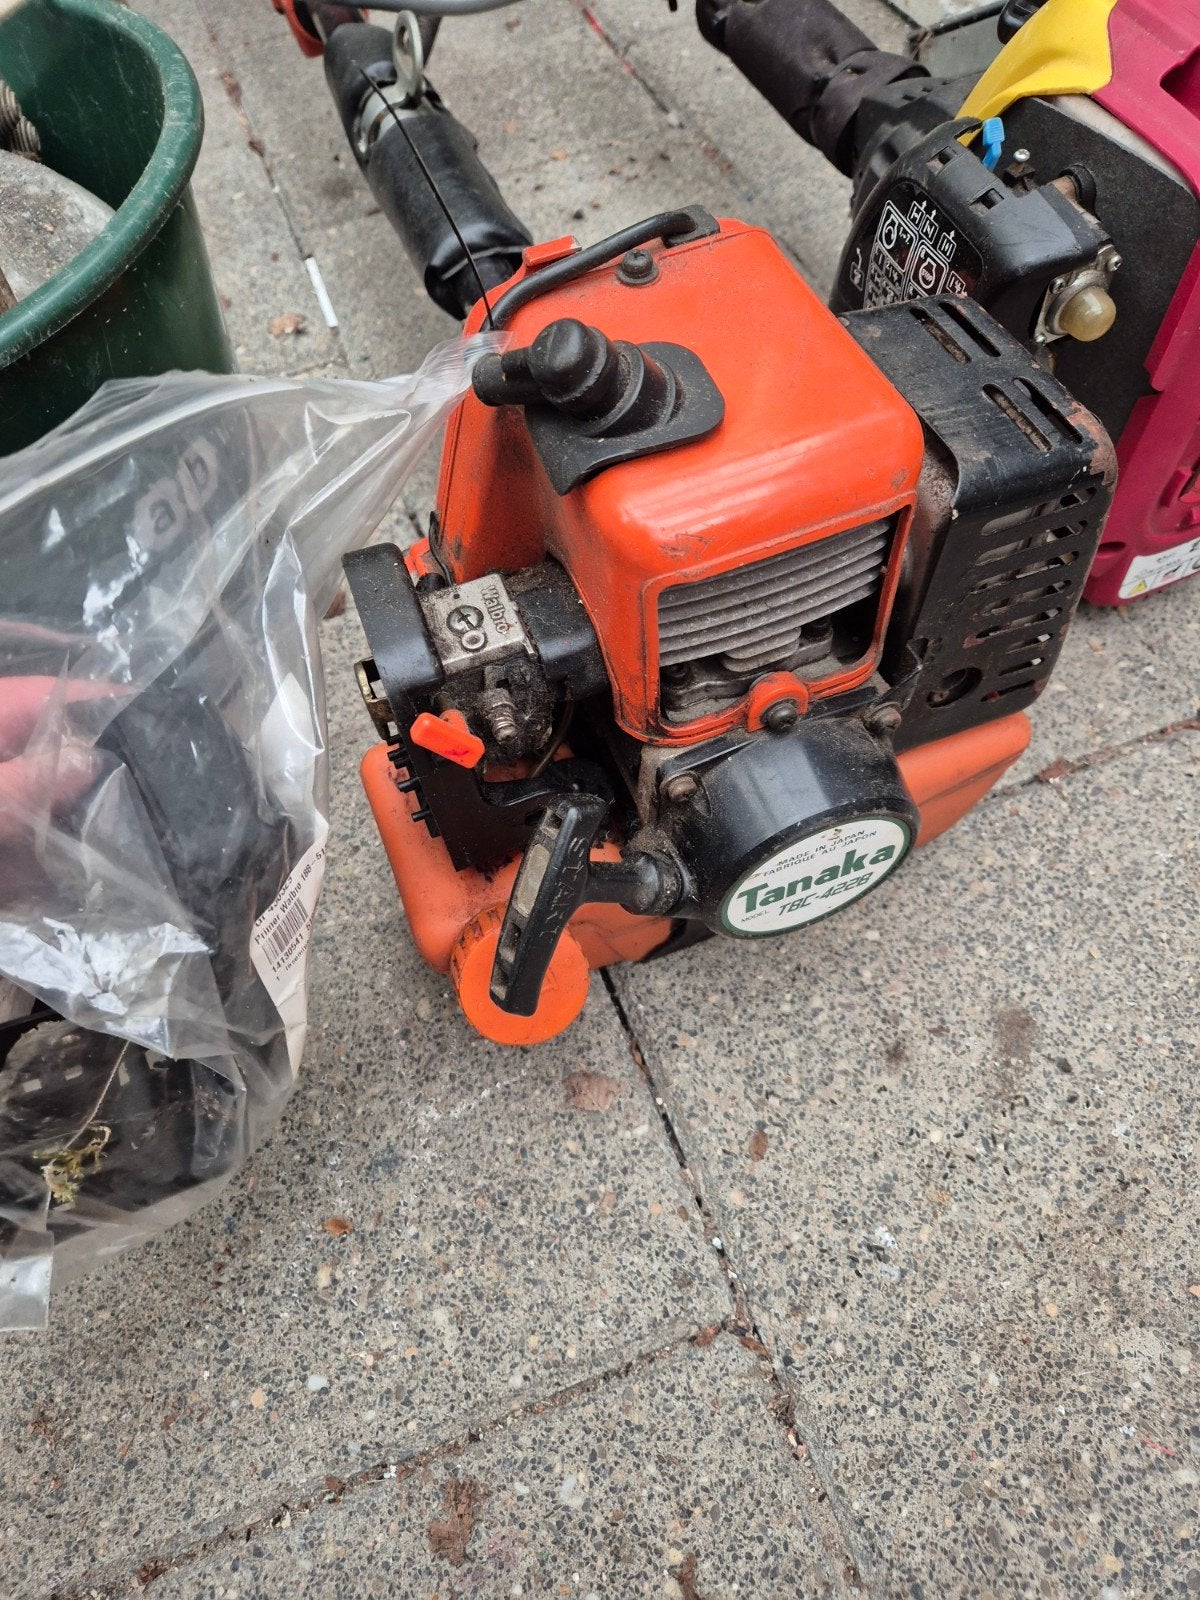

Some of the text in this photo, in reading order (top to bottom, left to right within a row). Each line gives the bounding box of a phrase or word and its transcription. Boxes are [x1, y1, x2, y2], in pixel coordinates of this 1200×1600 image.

[481, 585, 510, 635] Walbro
[763, 830, 877, 877] FABRIQUE AU JAPON
[777, 829, 866, 866] MADE IN JAPAN
[537, 836, 586, 942] START
[737, 844, 896, 914] Tanaka
[254, 914, 280, 945] Primer
[279, 882, 302, 916] Walbro
[740, 909, 768, 923] MODEL
[272, 932, 304, 973] 14130541
